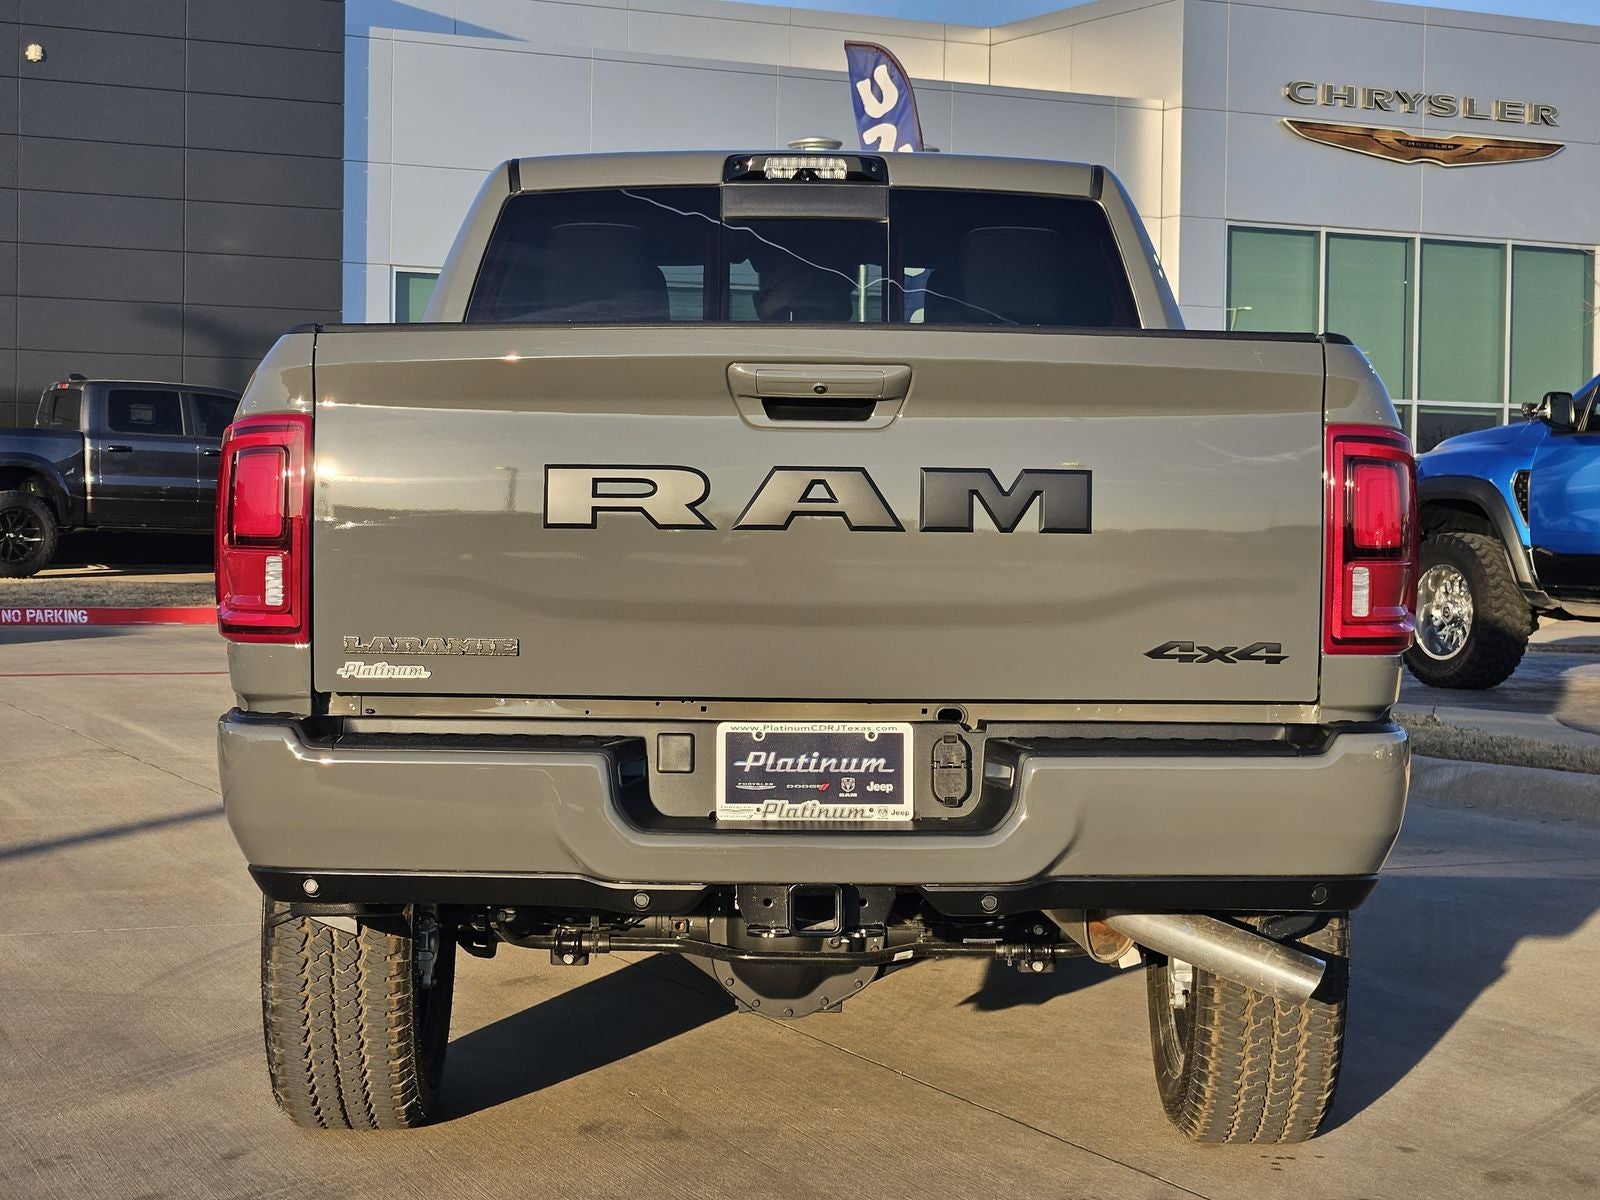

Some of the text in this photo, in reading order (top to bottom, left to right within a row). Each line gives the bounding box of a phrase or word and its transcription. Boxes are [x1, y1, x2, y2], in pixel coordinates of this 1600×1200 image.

[1283, 79, 1561, 127] CHRYSLER
[543, 463, 1093, 534] RAM
[1, 609, 89, 624] NO PARKING
[343, 635, 520, 656] LARAMIE
[1143, 640, 1290, 665] 4x4
[337, 661, 432, 679] Platinum
[730, 724, 898, 732] www.PlatinumCDRJTexas.com
[733, 751, 895, 773] Platinum
[866, 781, 894, 793] Jeep
[761, 802, 875, 819] Platinum
[890, 809, 910, 817] Jeep
